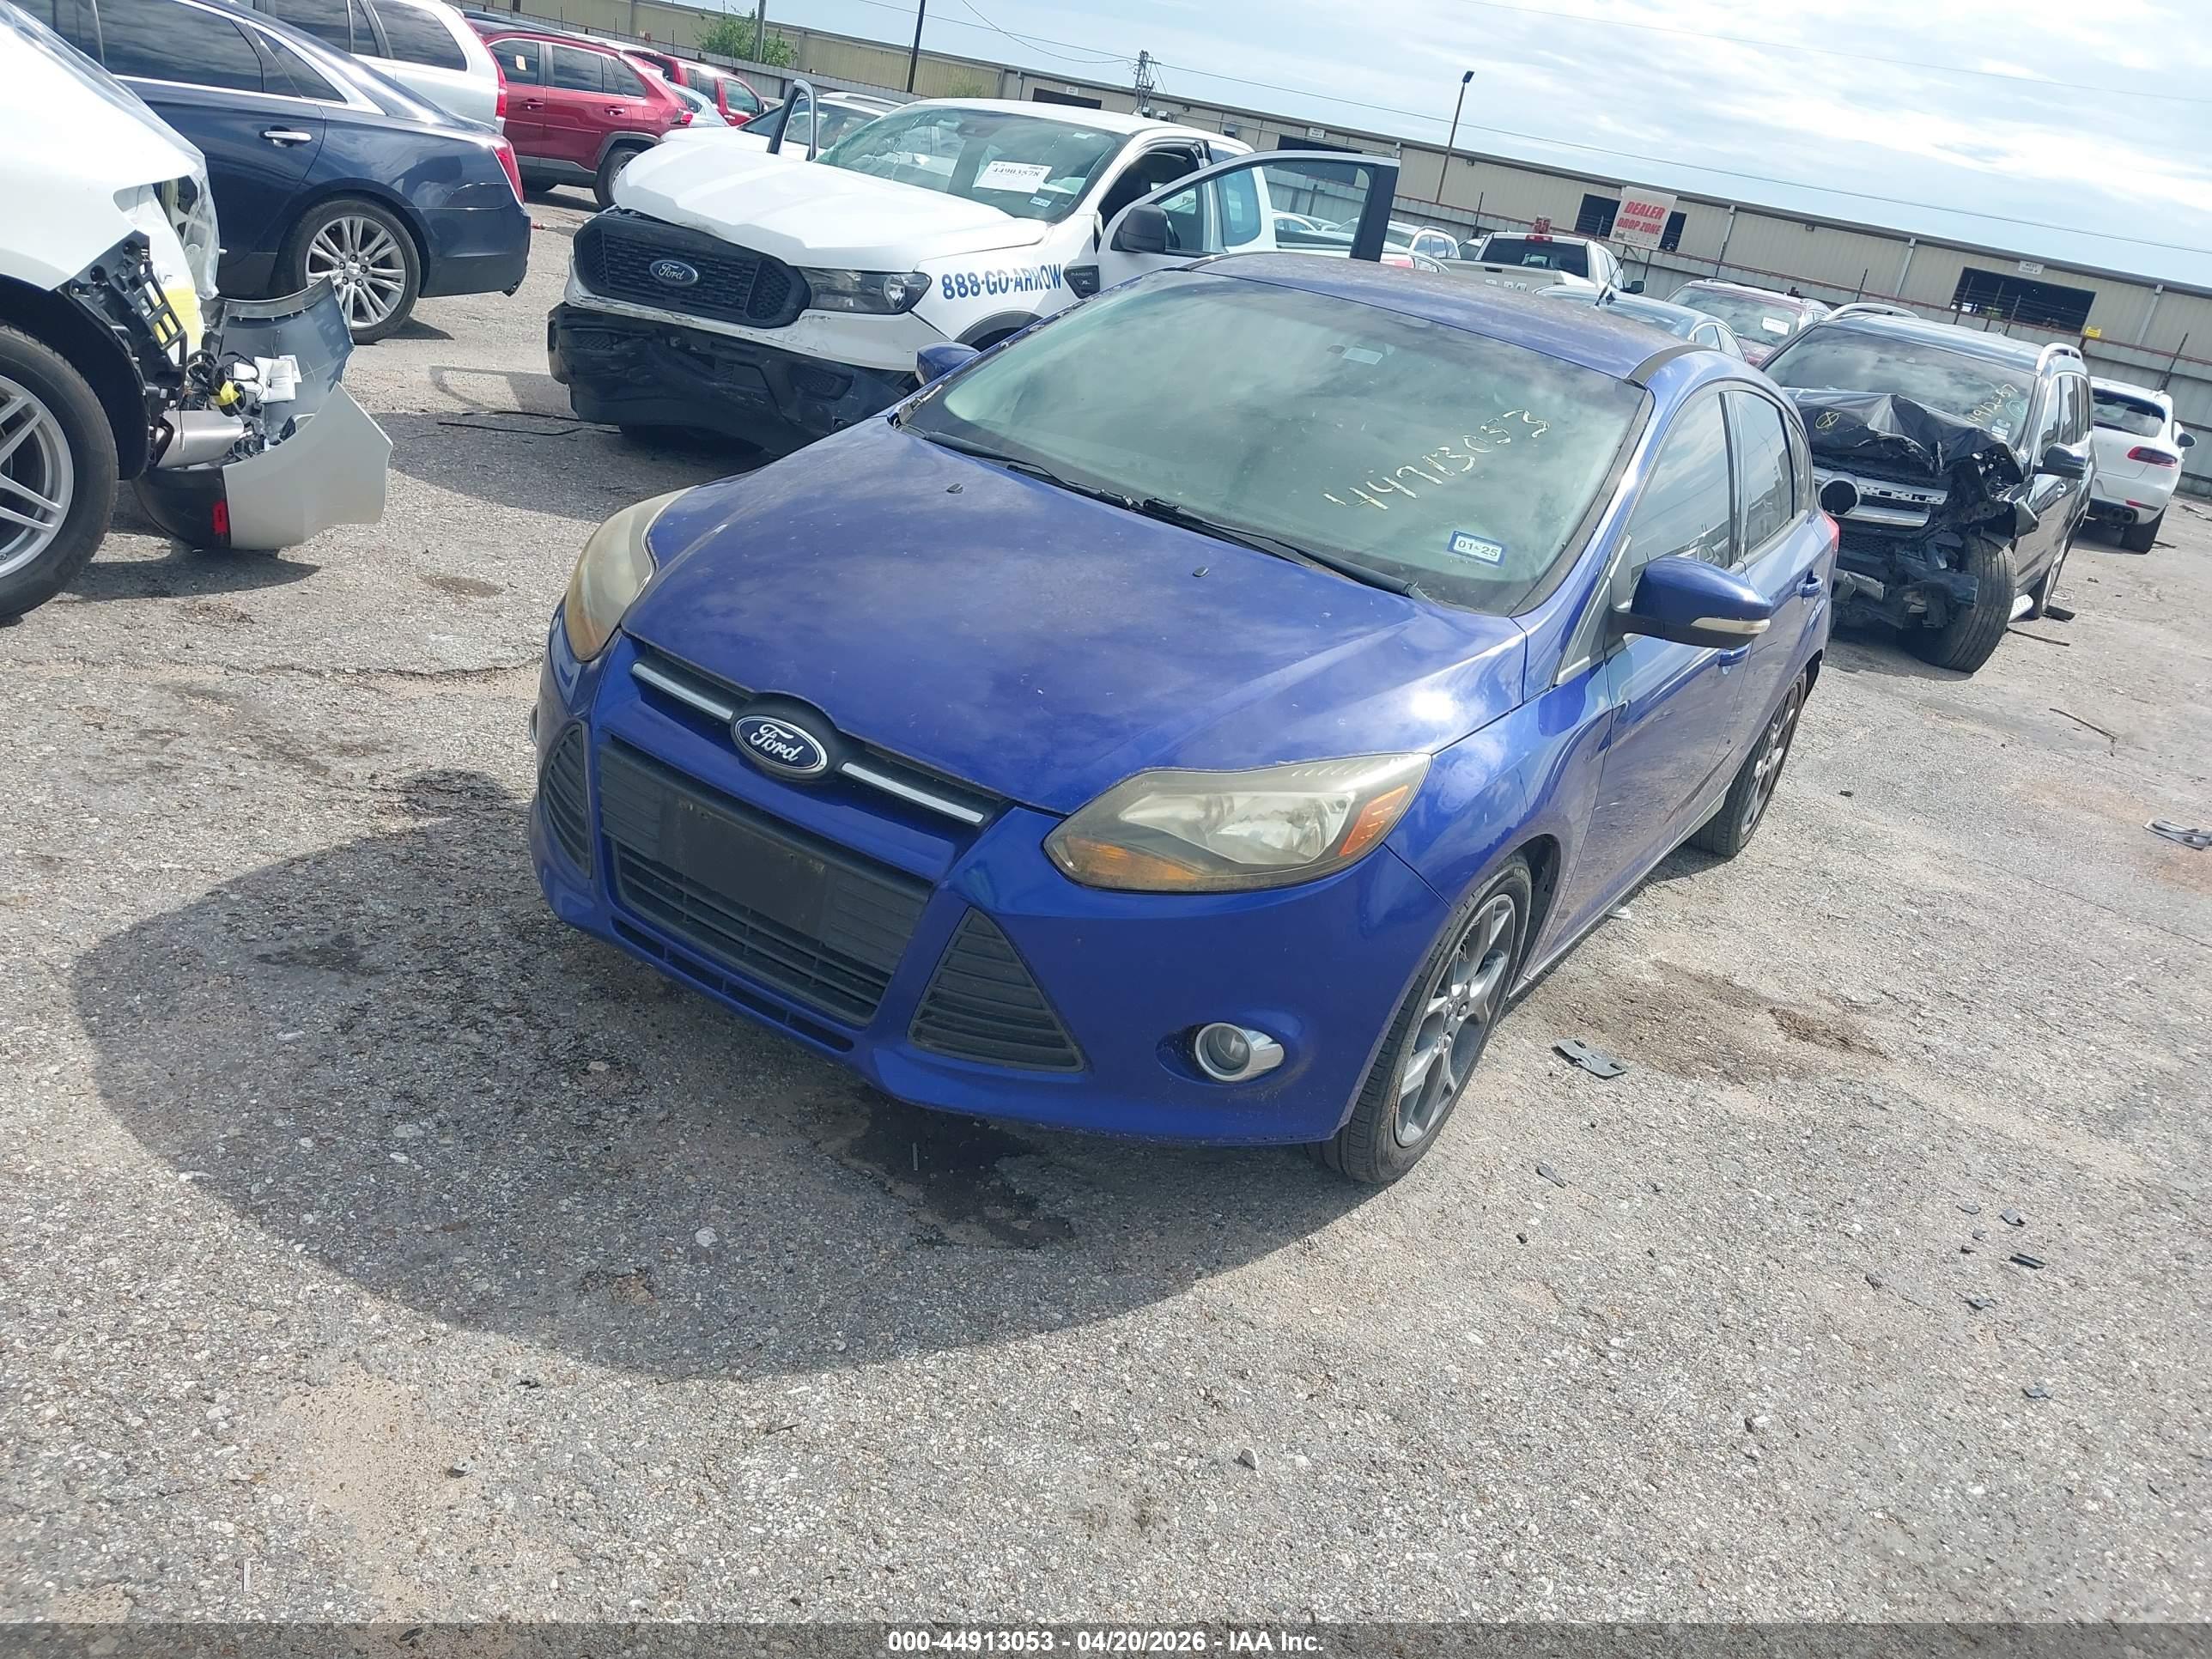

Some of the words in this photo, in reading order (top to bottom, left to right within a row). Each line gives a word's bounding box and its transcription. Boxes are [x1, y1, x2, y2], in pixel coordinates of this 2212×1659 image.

[1624, 201, 1665, 220] DEALER
[1617, 217, 1641, 230] DROP
[1639, 222, 1662, 234] ZONE
[659, 263, 685, 280] Ford
[1323, 410, 1550, 510] 44913053
[750, 723, 805, 762] Ford
